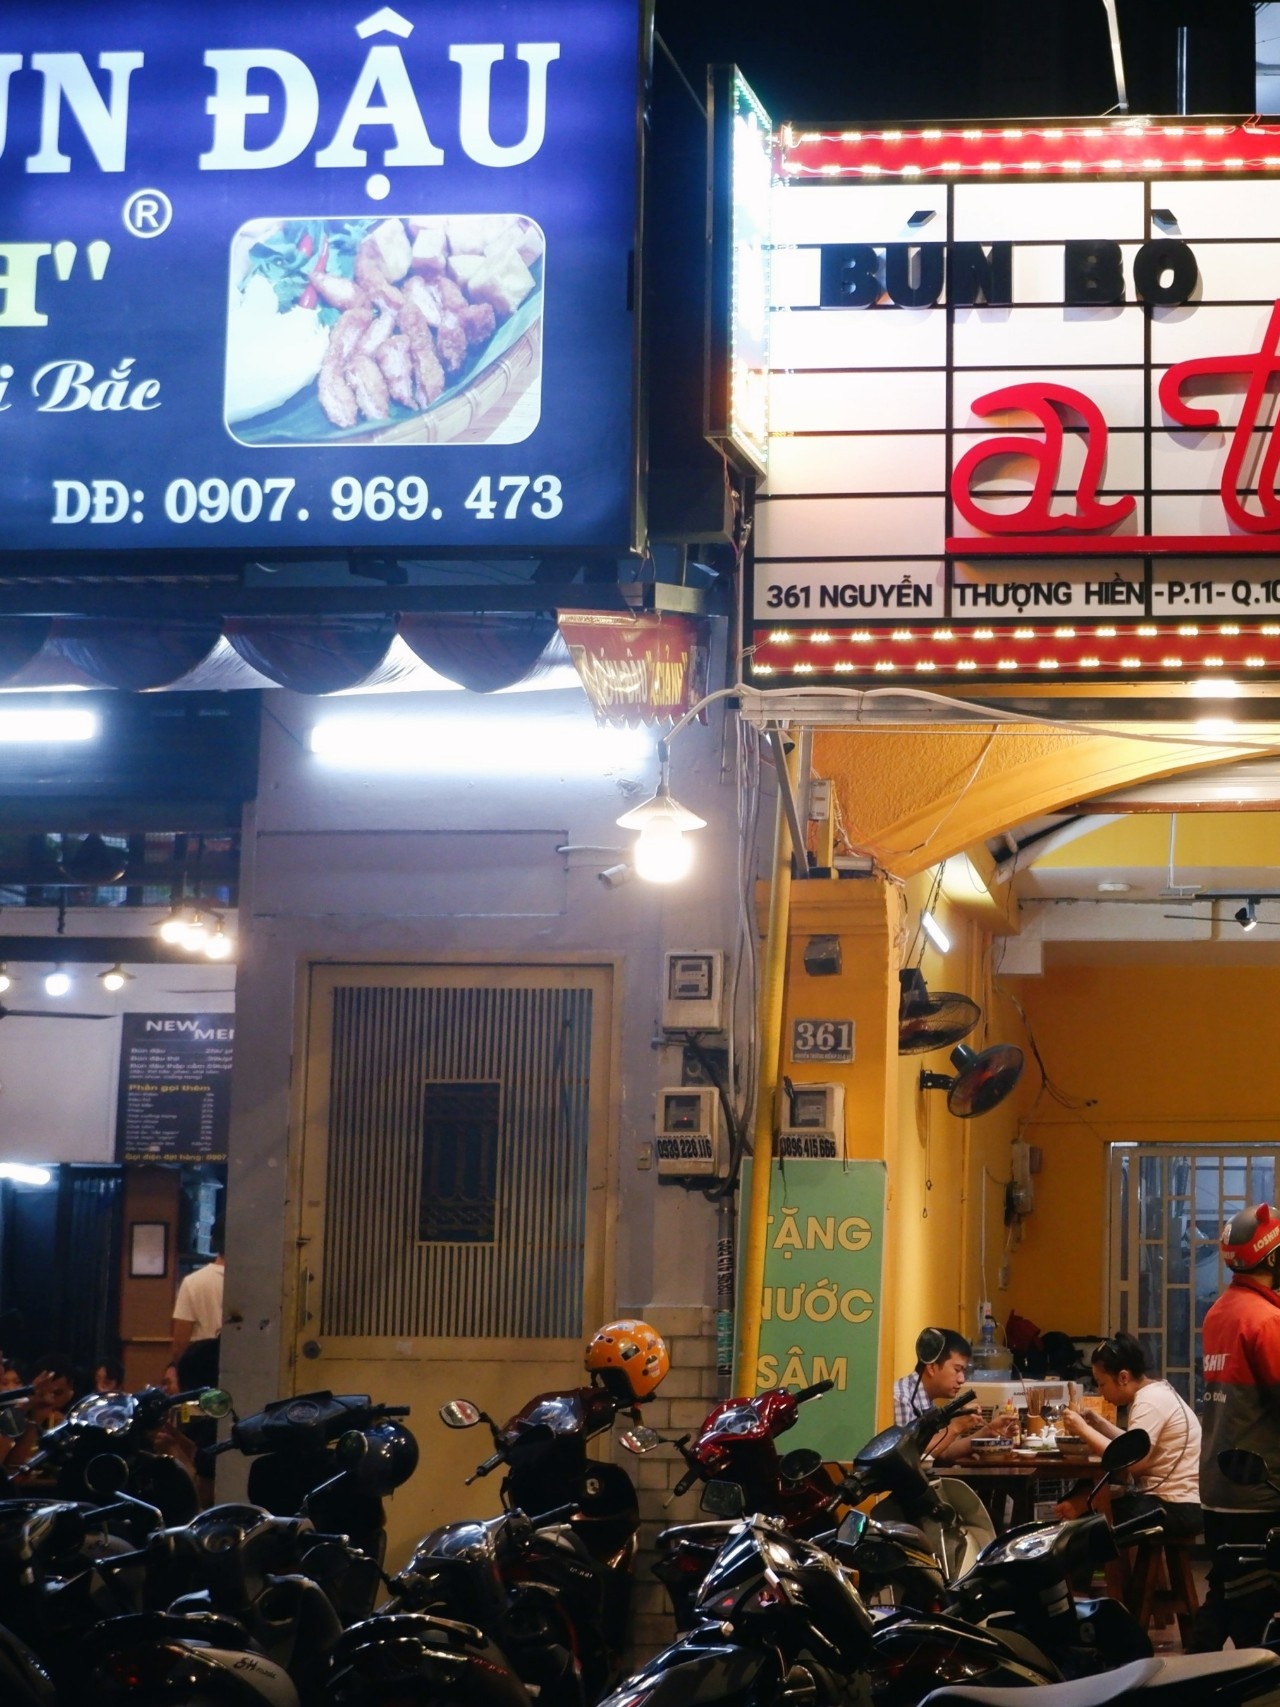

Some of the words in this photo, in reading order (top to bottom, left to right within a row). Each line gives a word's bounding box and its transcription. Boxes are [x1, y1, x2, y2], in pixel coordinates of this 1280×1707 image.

[199, 6, 561, 200] ĐẬU
[819, 209, 1014, 310] BÚN
[1064, 208, 1200, 308] BÒ
[31, 357, 162, 413] Bắc
[951, 381, 1136, 534] a
[51, 479, 145, 525] DĐ:
[165, 478, 309, 522] 0907.
[332, 476, 443, 520] 969.
[464, 474, 564, 520] 473
[766, 585, 811, 608] 361
[820, 575, 933, 608] NGUYỄN
[953, 582, 1073, 614] THƯỢNG
[1084, 571, 1145, 605] HIỀN
[146, 1020, 200, 1032] NEW
[795, 1021, 851, 1050] 361
[767, 1207, 873, 1260] ẶNG
[1252, 1226, 1280, 1252] LOSHIP
[756, 1346, 848, 1392] SÂM
